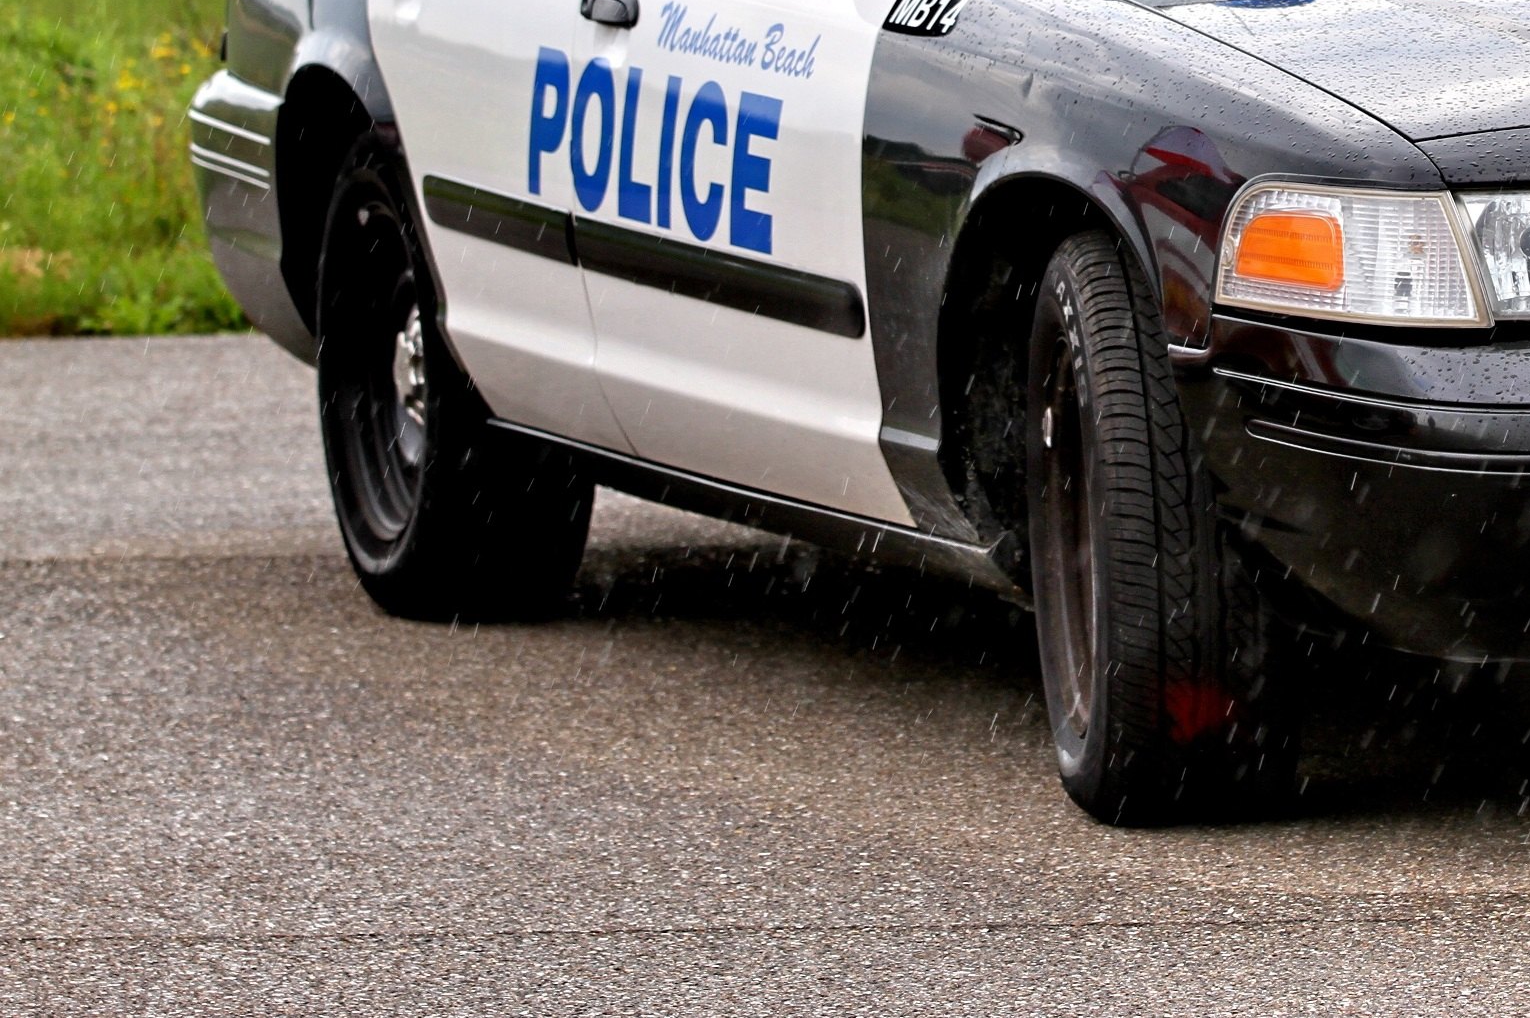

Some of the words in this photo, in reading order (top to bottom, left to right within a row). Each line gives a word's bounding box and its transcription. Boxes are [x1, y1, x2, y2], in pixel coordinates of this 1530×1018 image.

[657, 0, 758, 67] Manhattan
[760, 22, 822, 80] Beach
[528, 44, 784, 256] POLICE
